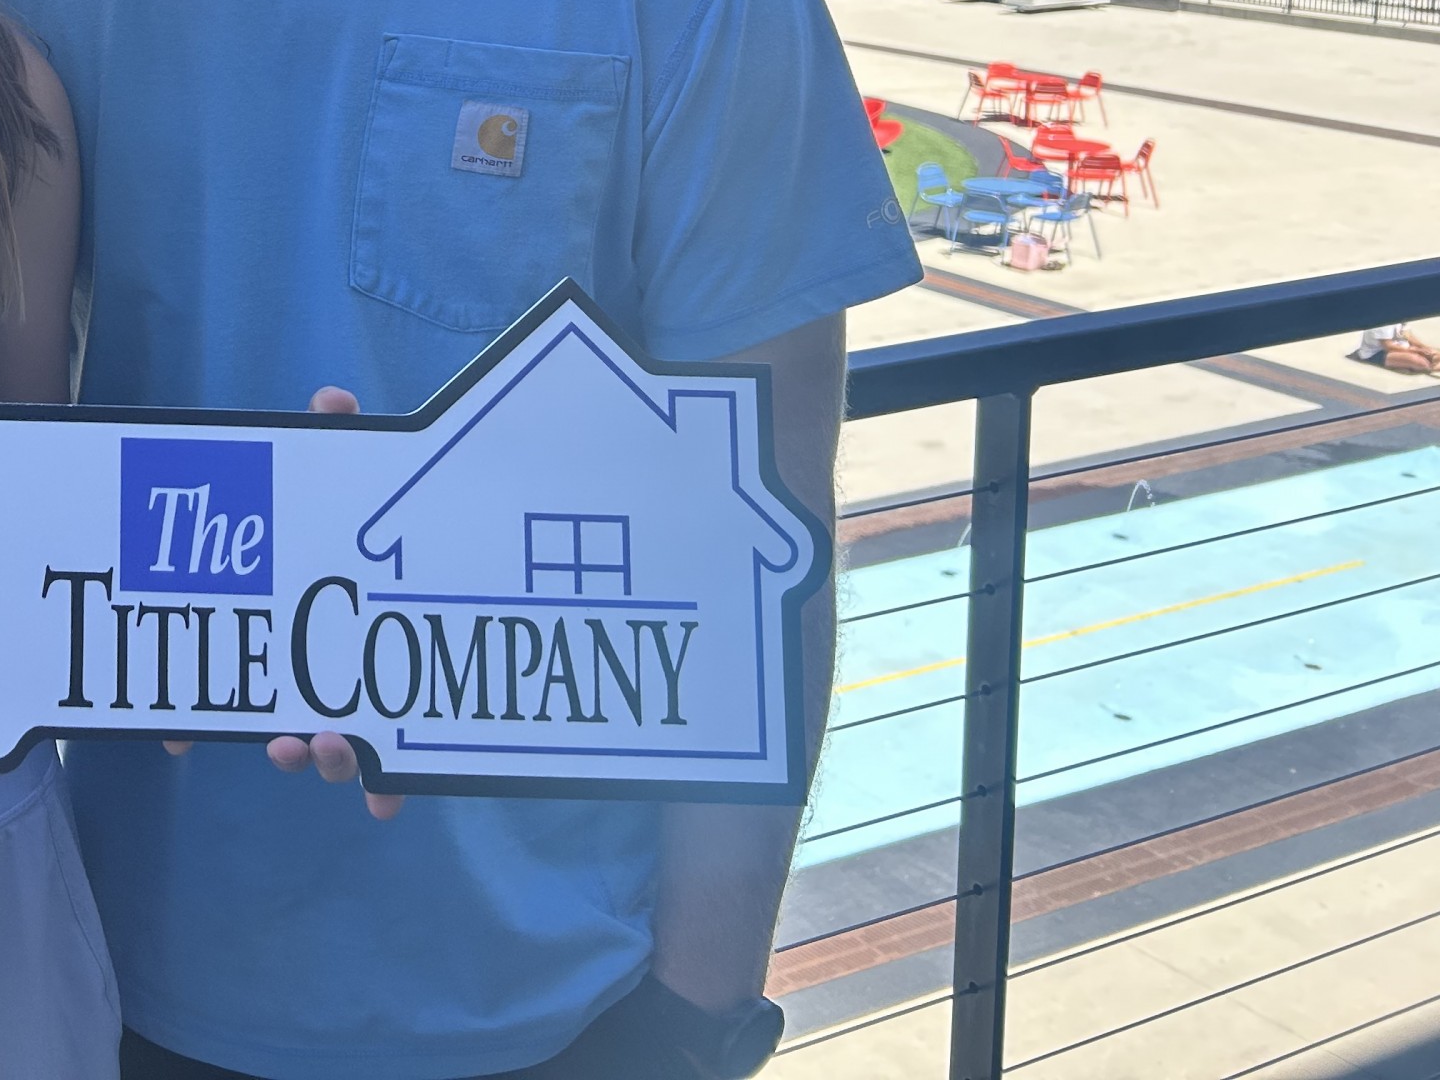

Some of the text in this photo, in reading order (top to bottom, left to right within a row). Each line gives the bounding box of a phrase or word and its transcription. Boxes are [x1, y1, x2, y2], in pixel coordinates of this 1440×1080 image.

[460, 155, 514, 168] carhartt
[148, 483, 265, 576] The
[41, 564, 699, 726] TITLE COMPANY
